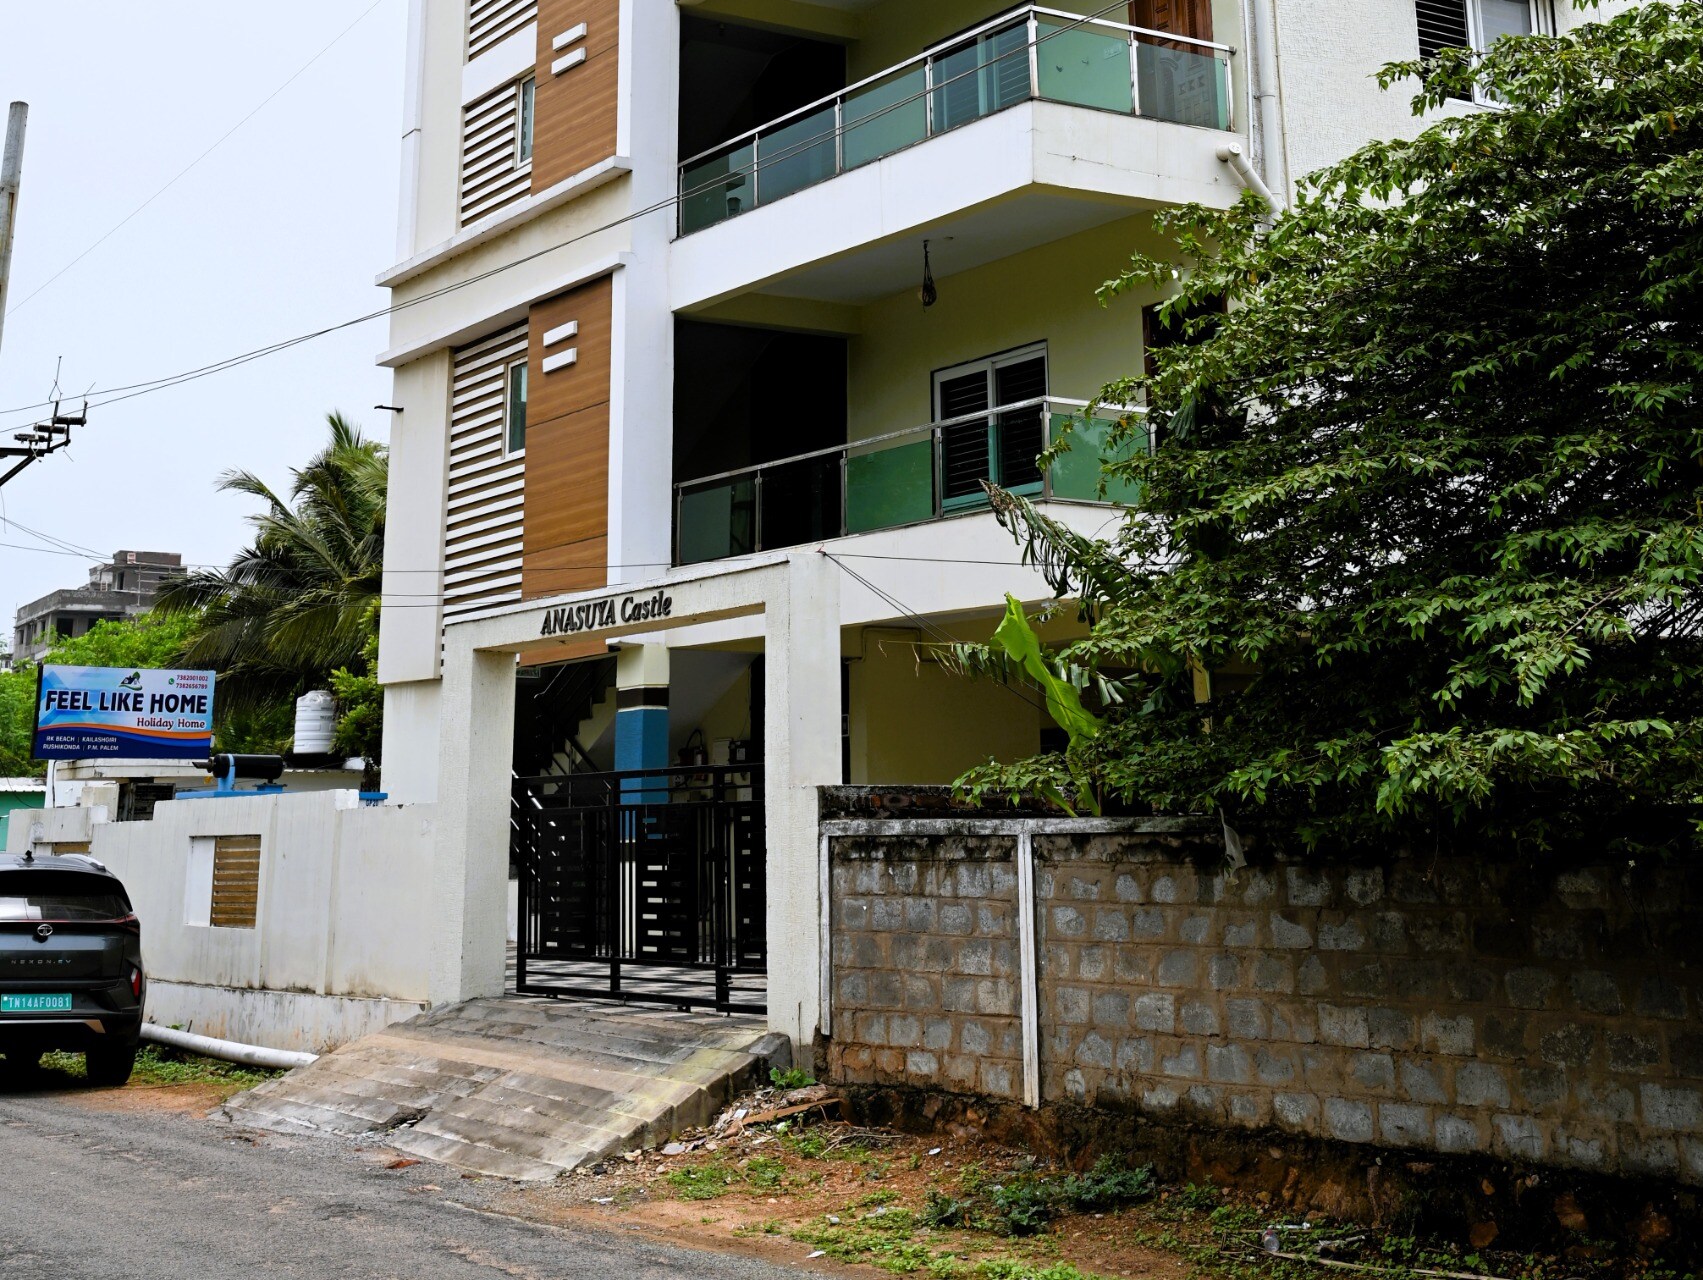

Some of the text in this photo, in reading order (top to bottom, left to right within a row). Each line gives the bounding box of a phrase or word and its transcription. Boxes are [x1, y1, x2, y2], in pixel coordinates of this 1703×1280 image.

[540, 590, 673, 635] ANASUYA Castle
[45, 690, 208, 714] FEEL LIKE HOME
[136, 717, 205, 730] Holiday Home
[8, 996, 69, 1008] TN14AF0081
